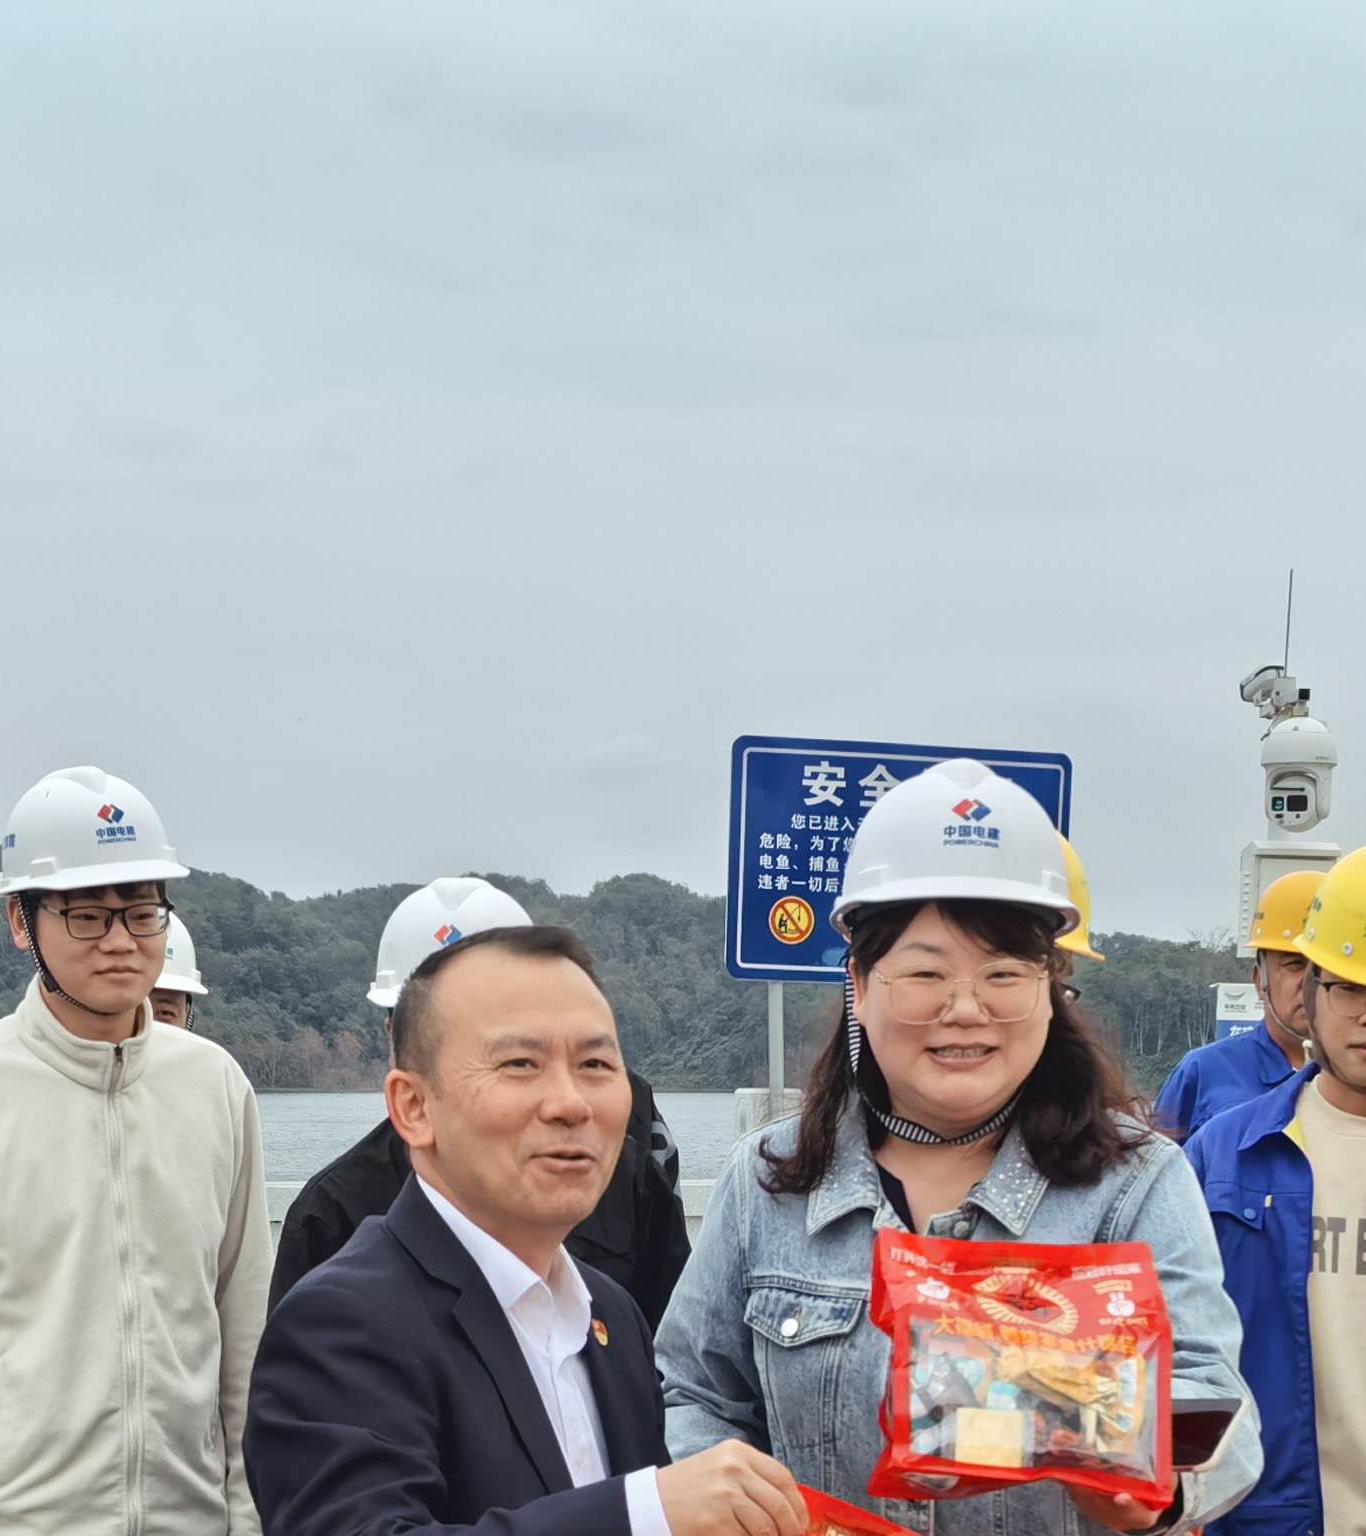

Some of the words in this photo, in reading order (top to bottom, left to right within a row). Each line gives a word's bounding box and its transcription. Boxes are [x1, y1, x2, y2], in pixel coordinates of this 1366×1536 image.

[791, 814, 863, 832] 您已进入
[943, 825, 1000, 841] 中国电建
[759, 854, 846, 873] 电鱼、捕鱼
[758, 874, 843, 894] 违者一切后
